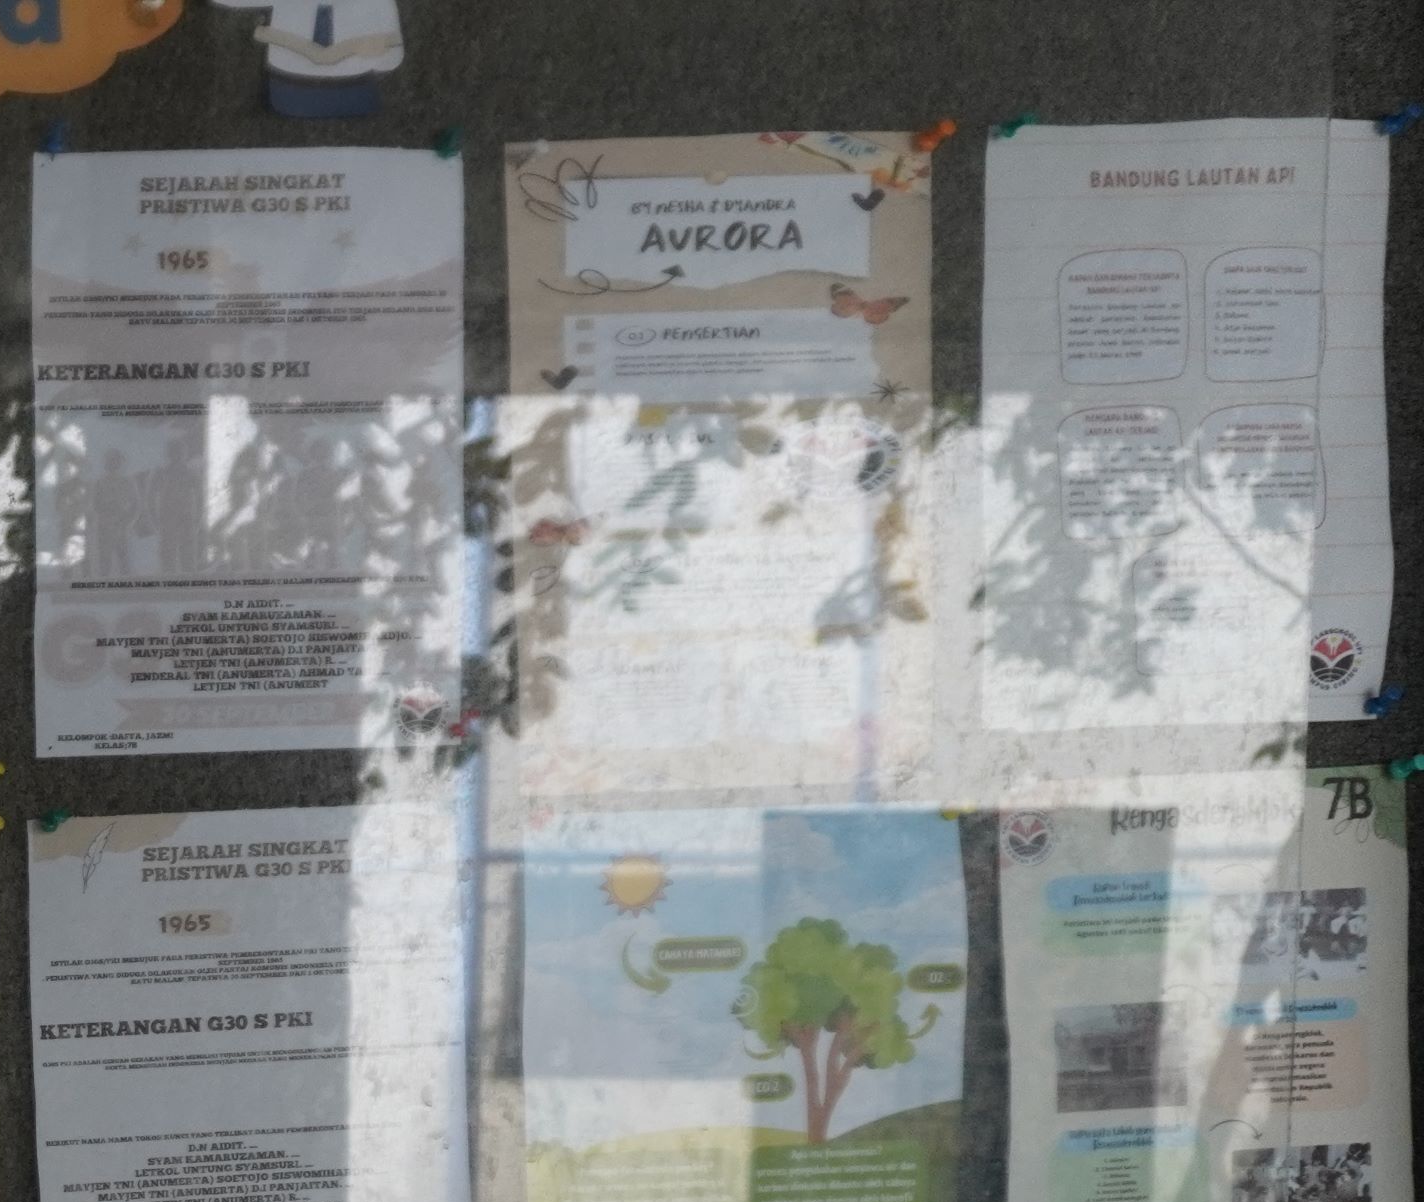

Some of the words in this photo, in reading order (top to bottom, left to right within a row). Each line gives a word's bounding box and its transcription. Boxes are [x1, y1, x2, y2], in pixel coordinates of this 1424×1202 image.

[139, 174, 241, 193] SEJARAH
[244, 172, 346, 192] SINGKAT
[1088, 169, 1180, 189] BANDUNG
[1185, 167, 1260, 186] LAUTAN
[1265, 166, 1296, 184] API
[139, 196, 247, 215] PRISTIWA
[252, 196, 291, 213] G30
[313, 195, 352, 212] PKI
[156, 249, 211, 271] 1965
[37, 361, 199, 382] KETERANGAN
[204, 361, 246, 380] G30
[250, 360, 266, 379] S
[271, 360, 311, 378] PKI
[1322, 777, 1374, 821] 7B
[142, 843, 243, 863] SEJARAH
[247, 838, 349, 858] SINGKAT
[140, 862, 248, 882] PRISTIWA
[254, 861, 293, 878] G30
[158, 914, 211, 933] 1965
[40, 1015, 202, 1041] KETERANGAN
[207, 1014, 248, 1032] G30
[253, 1012, 269, 1030] S
[273, 1011, 314, 1029] PKI
